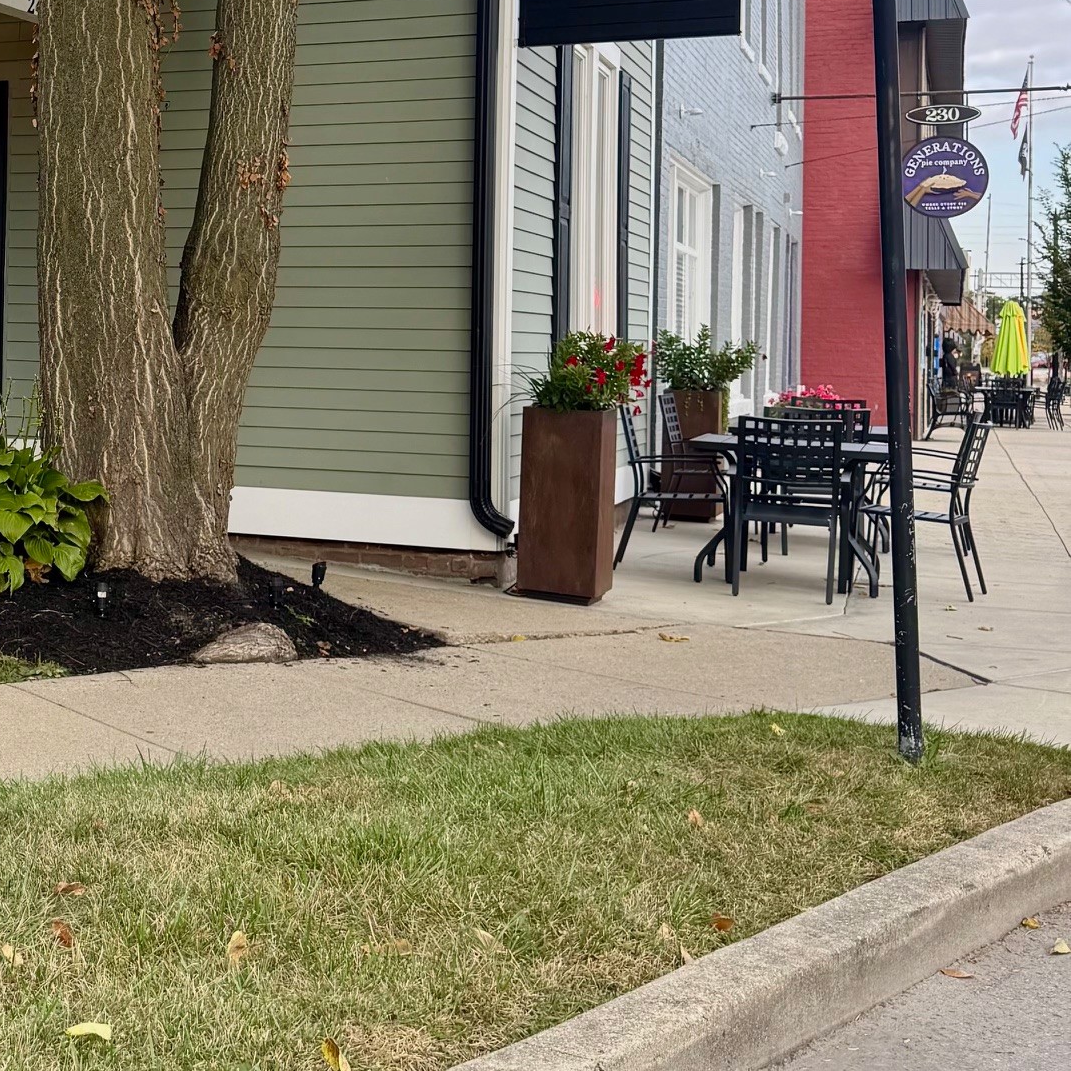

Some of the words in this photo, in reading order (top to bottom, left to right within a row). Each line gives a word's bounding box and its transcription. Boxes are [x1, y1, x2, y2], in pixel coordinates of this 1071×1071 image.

[925, 107, 960, 122] 230
[904, 141, 985, 178] GENERATIONS
[921, 159, 933, 168] pie
[934, 158, 968, 167] company
